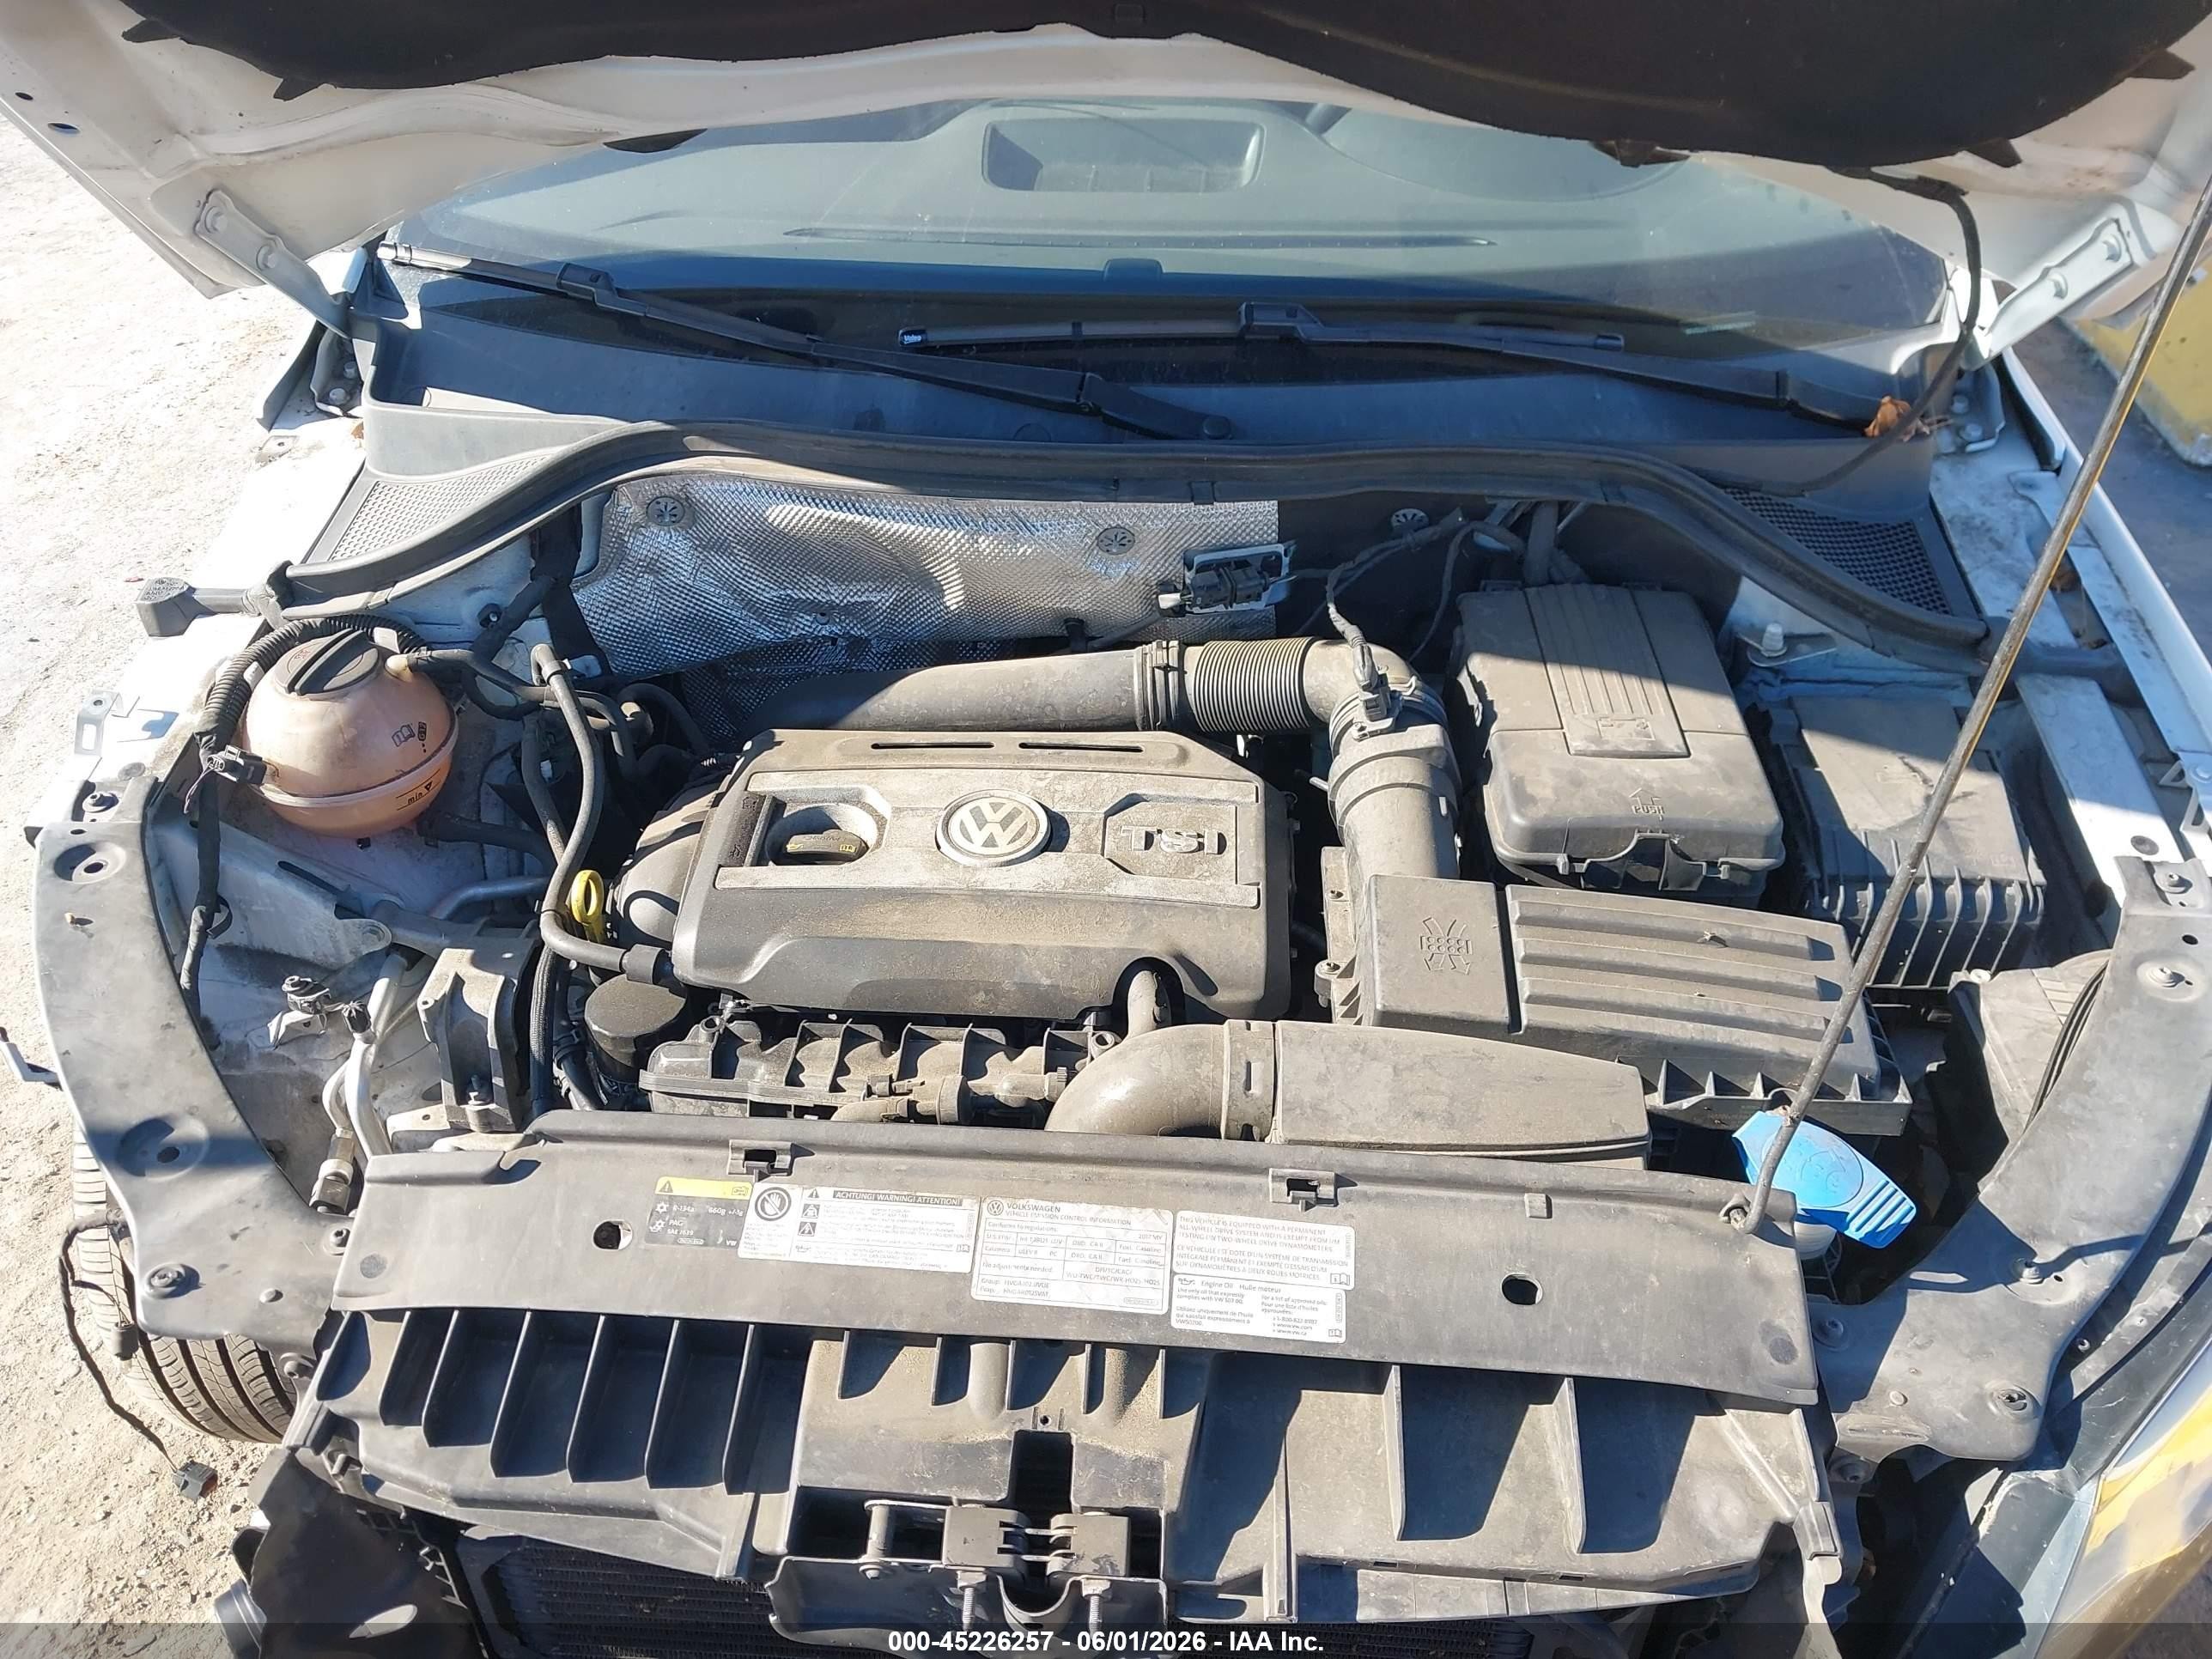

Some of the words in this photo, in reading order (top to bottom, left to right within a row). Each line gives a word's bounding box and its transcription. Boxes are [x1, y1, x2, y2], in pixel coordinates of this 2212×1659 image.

[407, 792, 423, 805] min
[1632, 805, 1665, 815] PUSH
[1120, 824, 1219, 856] TSI
[876, 1194, 916, 1203] WARNING!
[917, 1197, 961, 1206] ATTENTION!
[1006, 1202, 1060, 1212] VOLKSWAGEN
[1060, 1213, 1087, 1222] CONTROL
[1089, 1216, 1131, 1225] INFORMATION
[1228, 1220, 1261, 1229] EQUIPPED
[1286, 1225, 1325, 1235] PERMANENT
[1200, 1279, 1223, 1289] Engine
[1257, 1285, 1281, 1293] moteur
